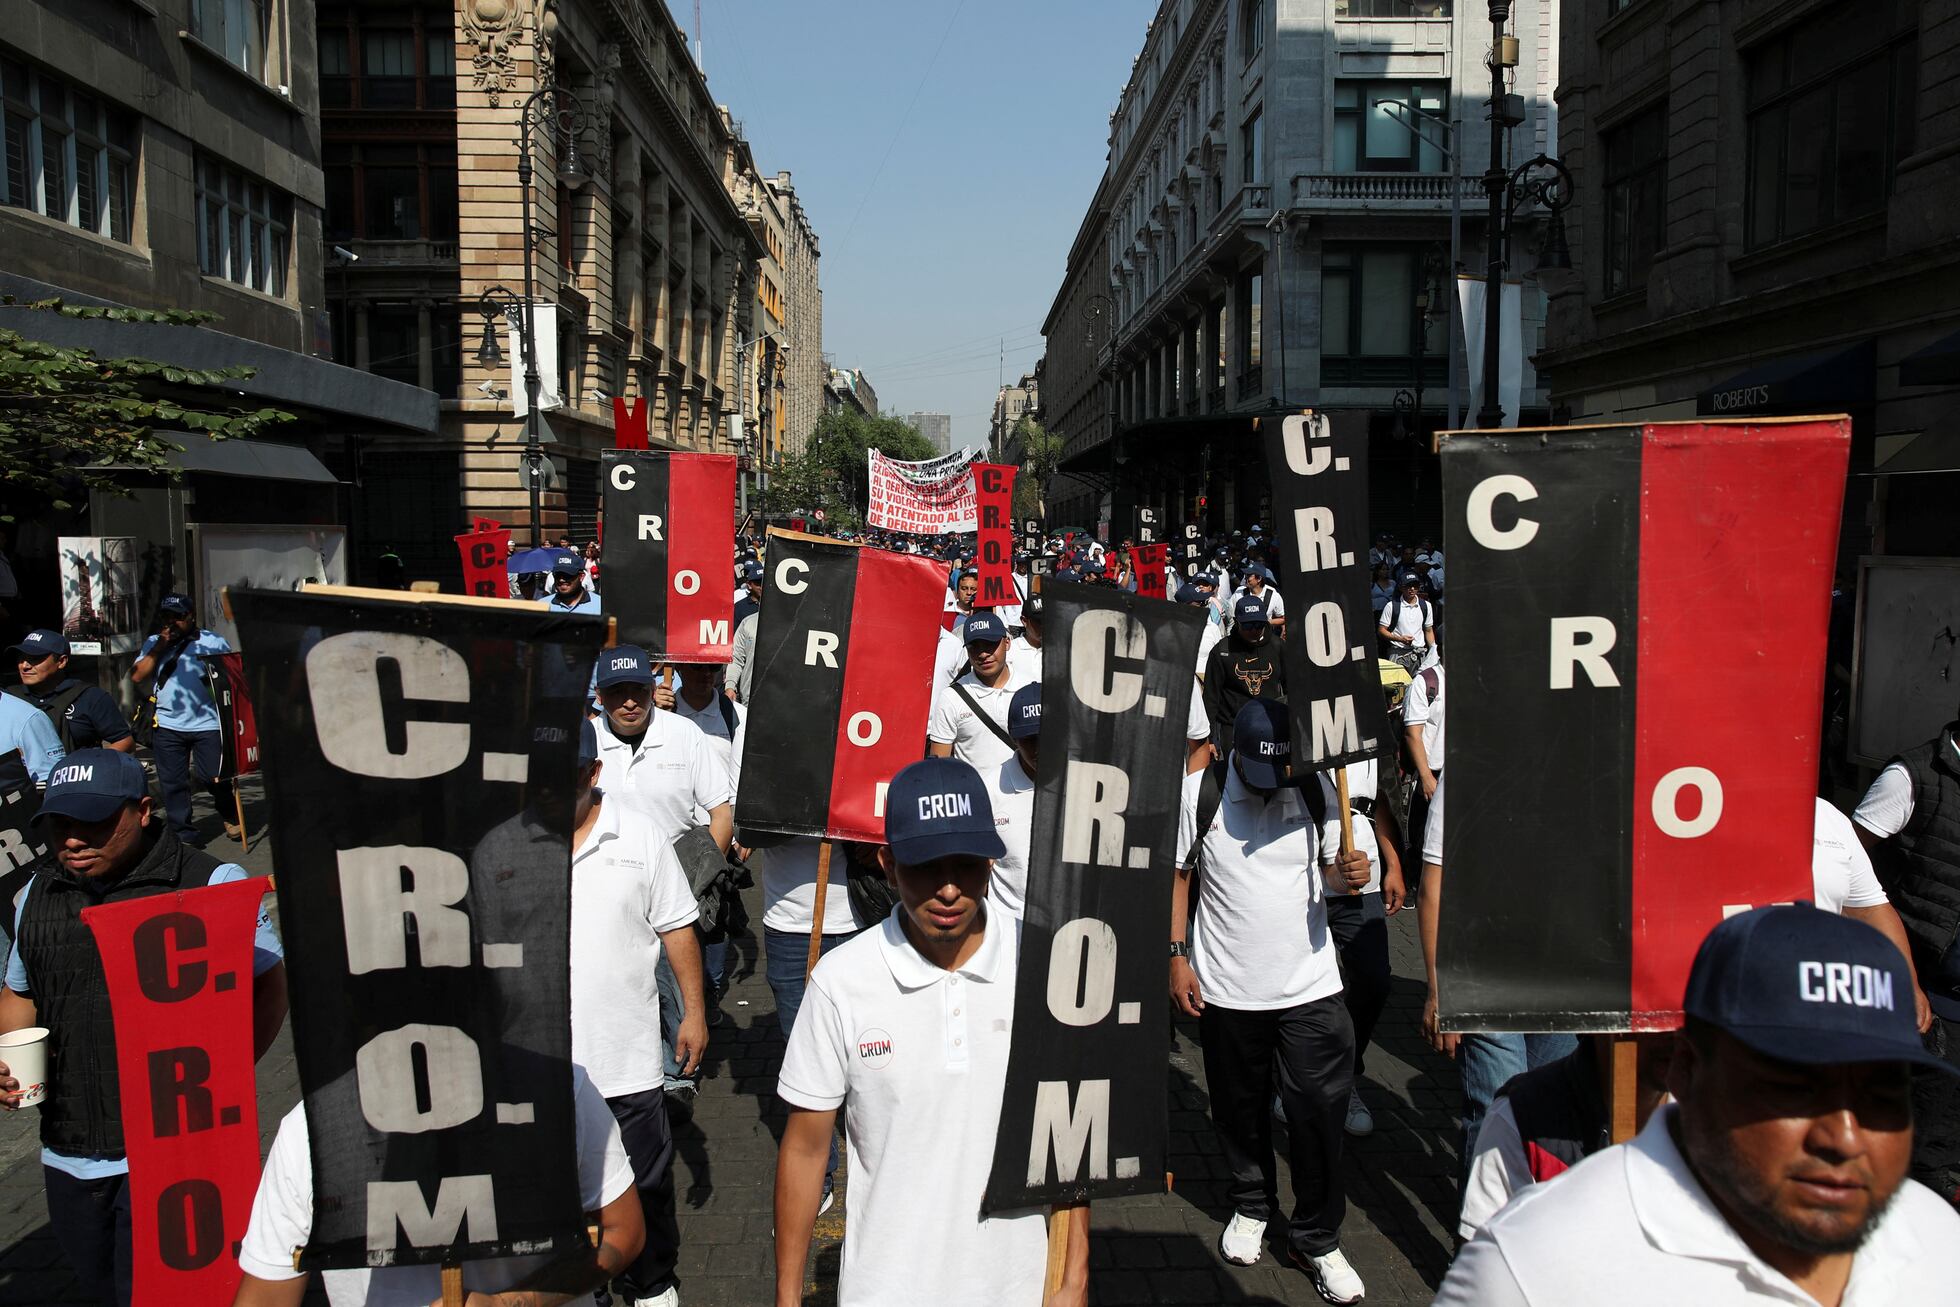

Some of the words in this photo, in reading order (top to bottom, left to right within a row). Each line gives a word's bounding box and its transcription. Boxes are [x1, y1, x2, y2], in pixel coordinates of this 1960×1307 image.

[872, 475, 884, 488] AL
[870, 486, 884, 500] SU
[869, 498, 884, 513] UN
[886, 504, 945, 524] ATENTADO
[947, 511, 960, 523] AL
[869, 511, 883, 526] DE
[970, 620, 990, 632] CROM
[611, 657, 638, 671] CROM
[1022, 703, 1042, 718] CRO
[52, 765, 94, 788] CROM
[918, 791, 971, 821] CROM
[1799, 961, 1895, 1013] CROM
[859, 1039, 892, 1058] CROM
